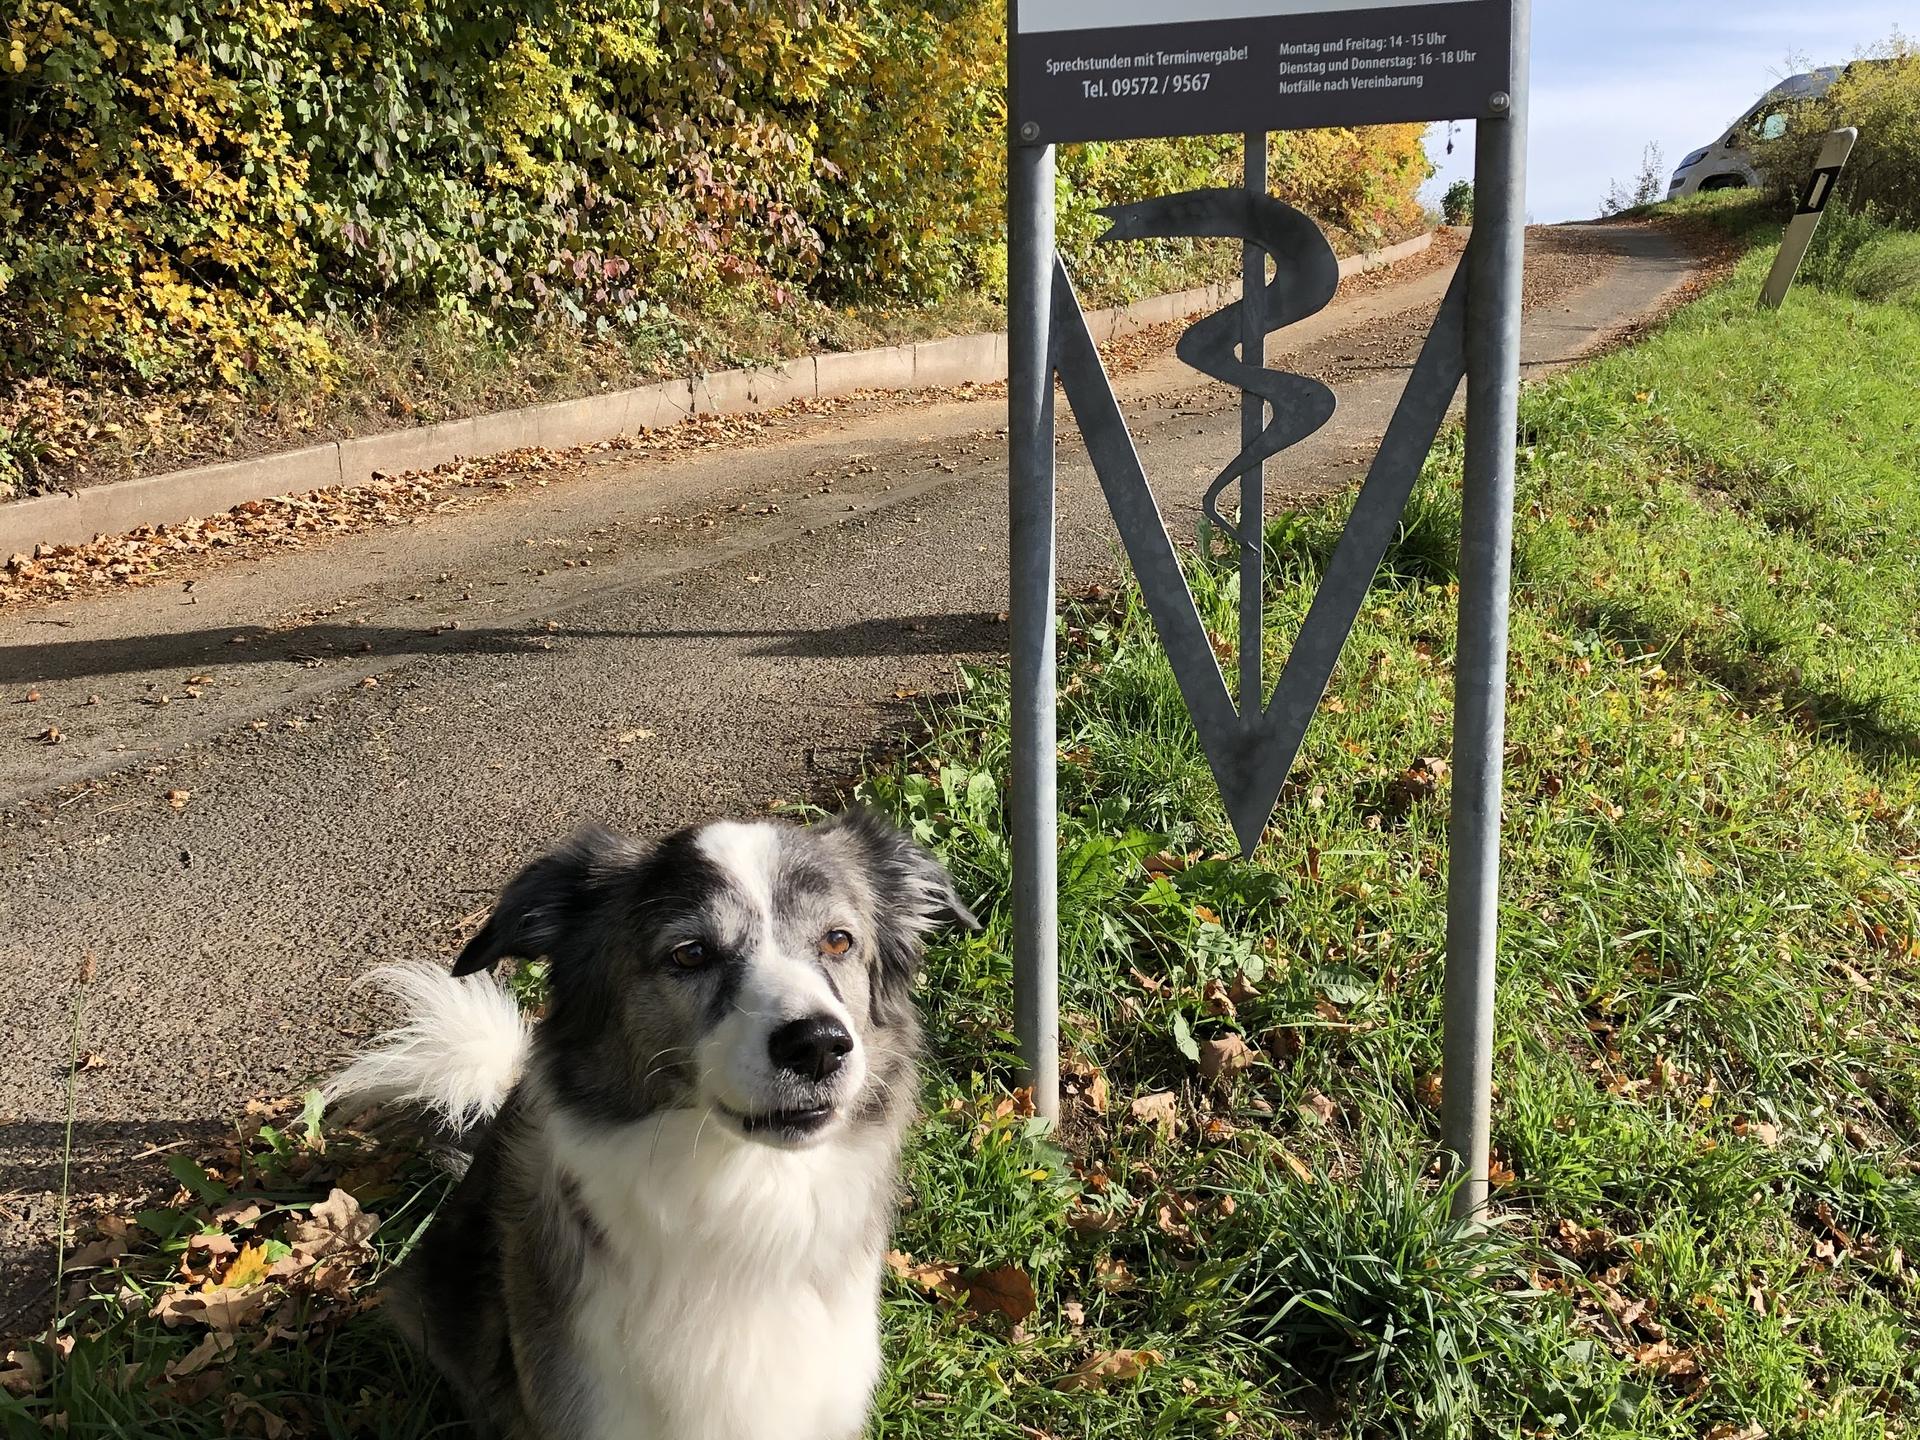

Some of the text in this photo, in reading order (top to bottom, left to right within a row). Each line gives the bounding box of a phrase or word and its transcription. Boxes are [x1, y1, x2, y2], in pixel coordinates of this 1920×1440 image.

[1280, 42, 1321, 56] Montag
[1322, 38, 1344, 53] und
[1345, 37, 1388, 52] Freitag:
[1389, 34, 1403, 48] 14
[1411, 33, 1425, 46] 15
[1426, 31, 1447, 46] Uhr
[1046, 46, 1249, 76] Sprechstunden mit Terminvergabe!
[1280, 61, 1327, 76] Dienstag
[1328, 57, 1349, 72] und
[1351, 55, 1417, 70] Donnerstag:
[1419, 52, 1433, 65] 16
[1441, 51, 1454, 64] 18
[1456, 49, 1477, 63] Uhr
[1082, 72, 1212, 98] Tel. 09572 / 9567
[1280, 75, 1424, 95] Notfälle nach Vereinbarung
